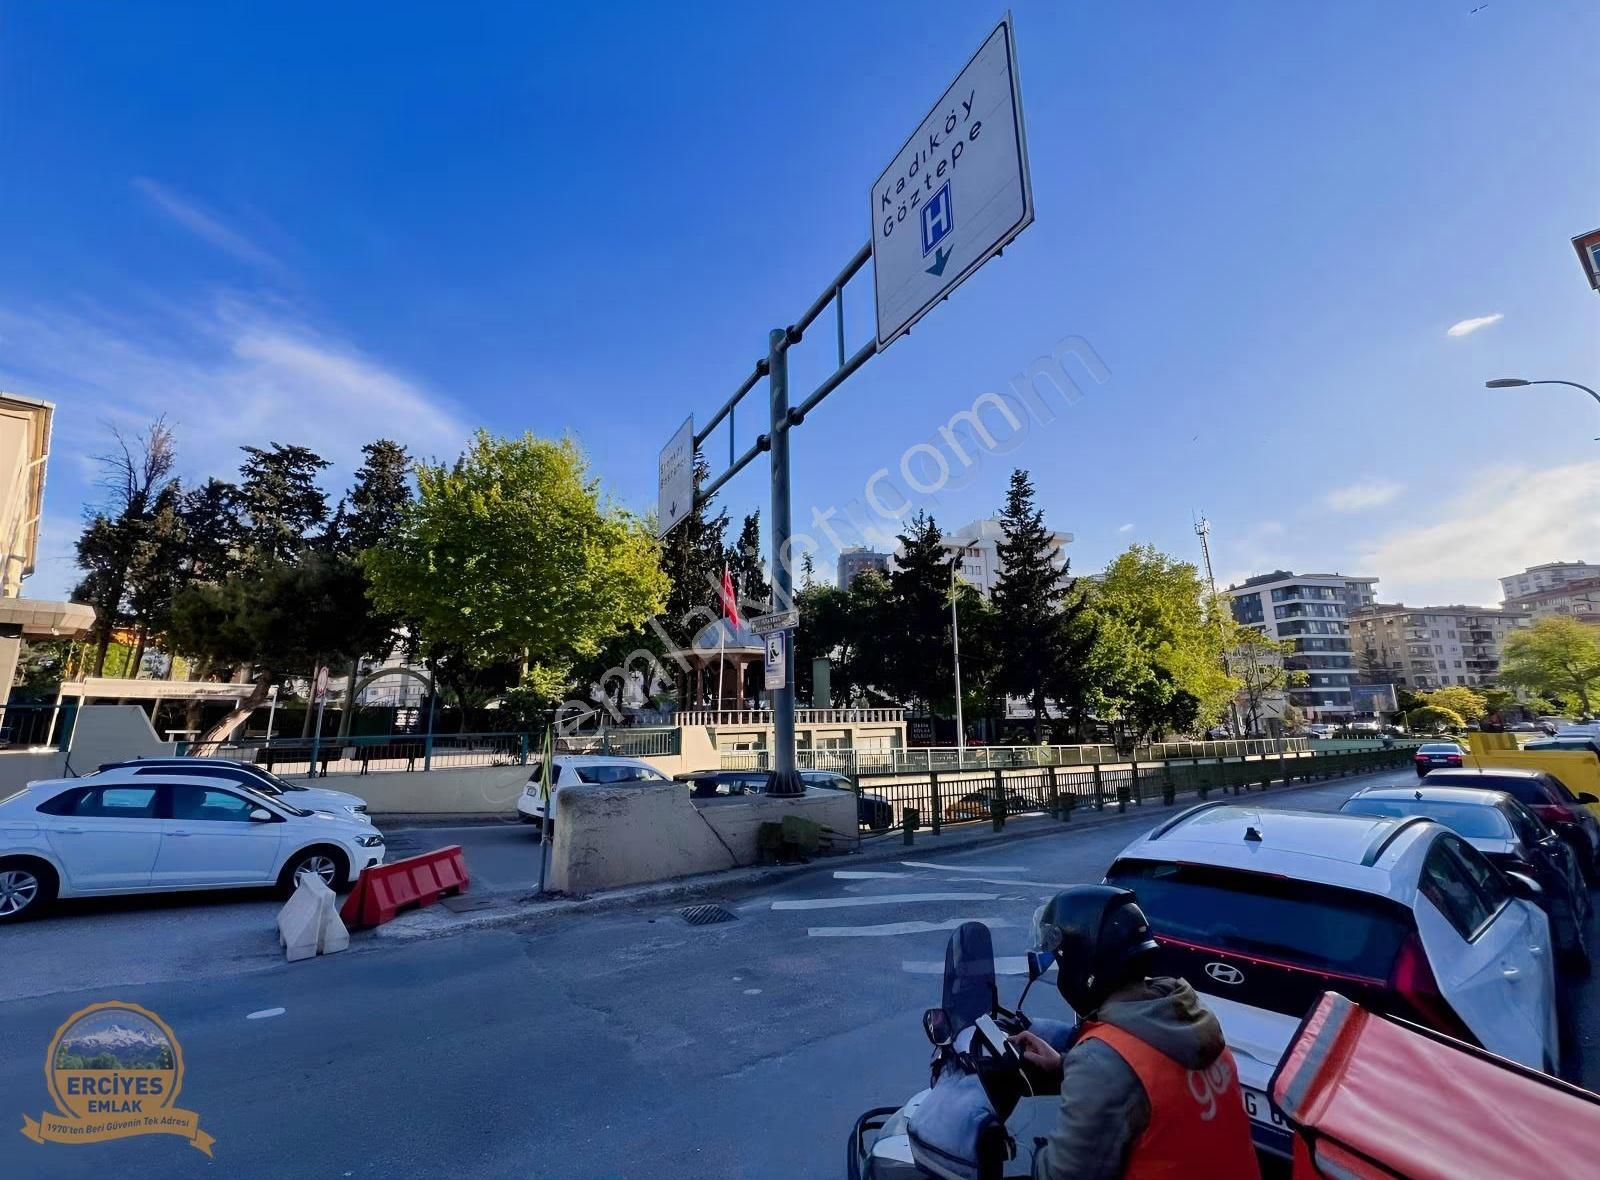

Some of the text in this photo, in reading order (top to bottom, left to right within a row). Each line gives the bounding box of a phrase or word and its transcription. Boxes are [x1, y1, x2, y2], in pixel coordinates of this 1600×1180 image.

[881, 90, 975, 212] Kadıköy
[884, 120, 982, 238] Göztepe
[924, 184, 949, 247] H
